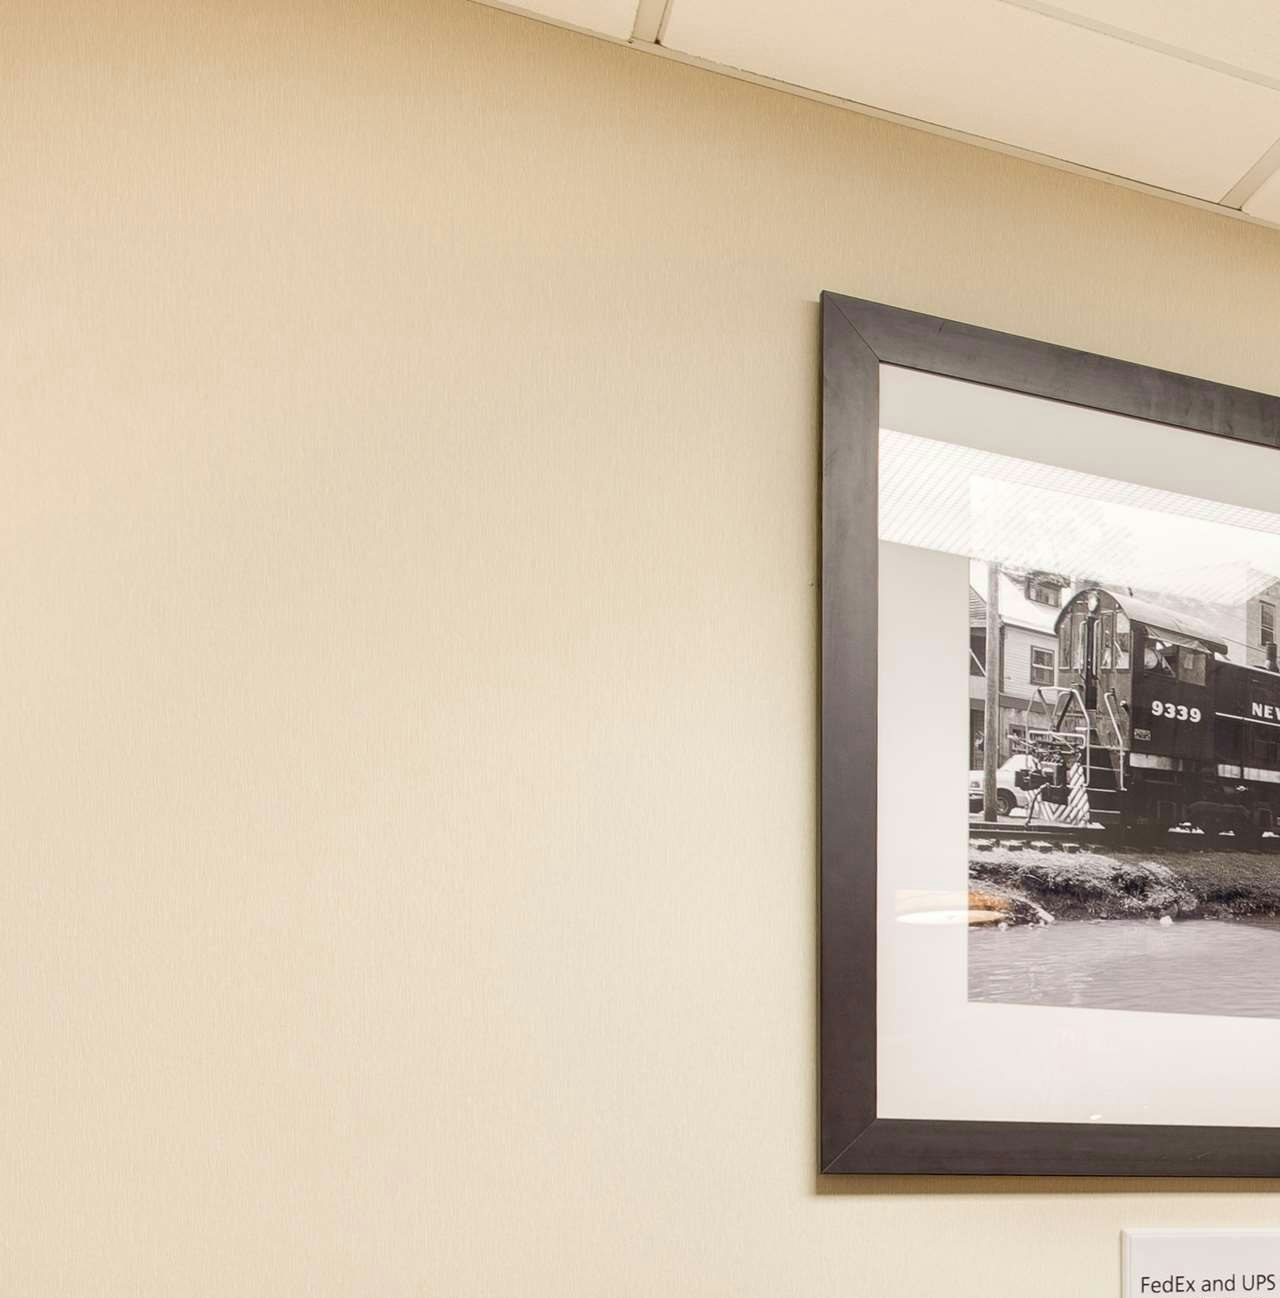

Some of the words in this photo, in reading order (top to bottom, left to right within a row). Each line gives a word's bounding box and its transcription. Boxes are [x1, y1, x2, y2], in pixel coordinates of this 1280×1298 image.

[1151, 700, 1202, 723] 9339
[1141, 1275, 1196, 1294] FedEx
[1201, 1274, 1236, 1293] and
[1242, 1274, 1276, 1292] UPS
